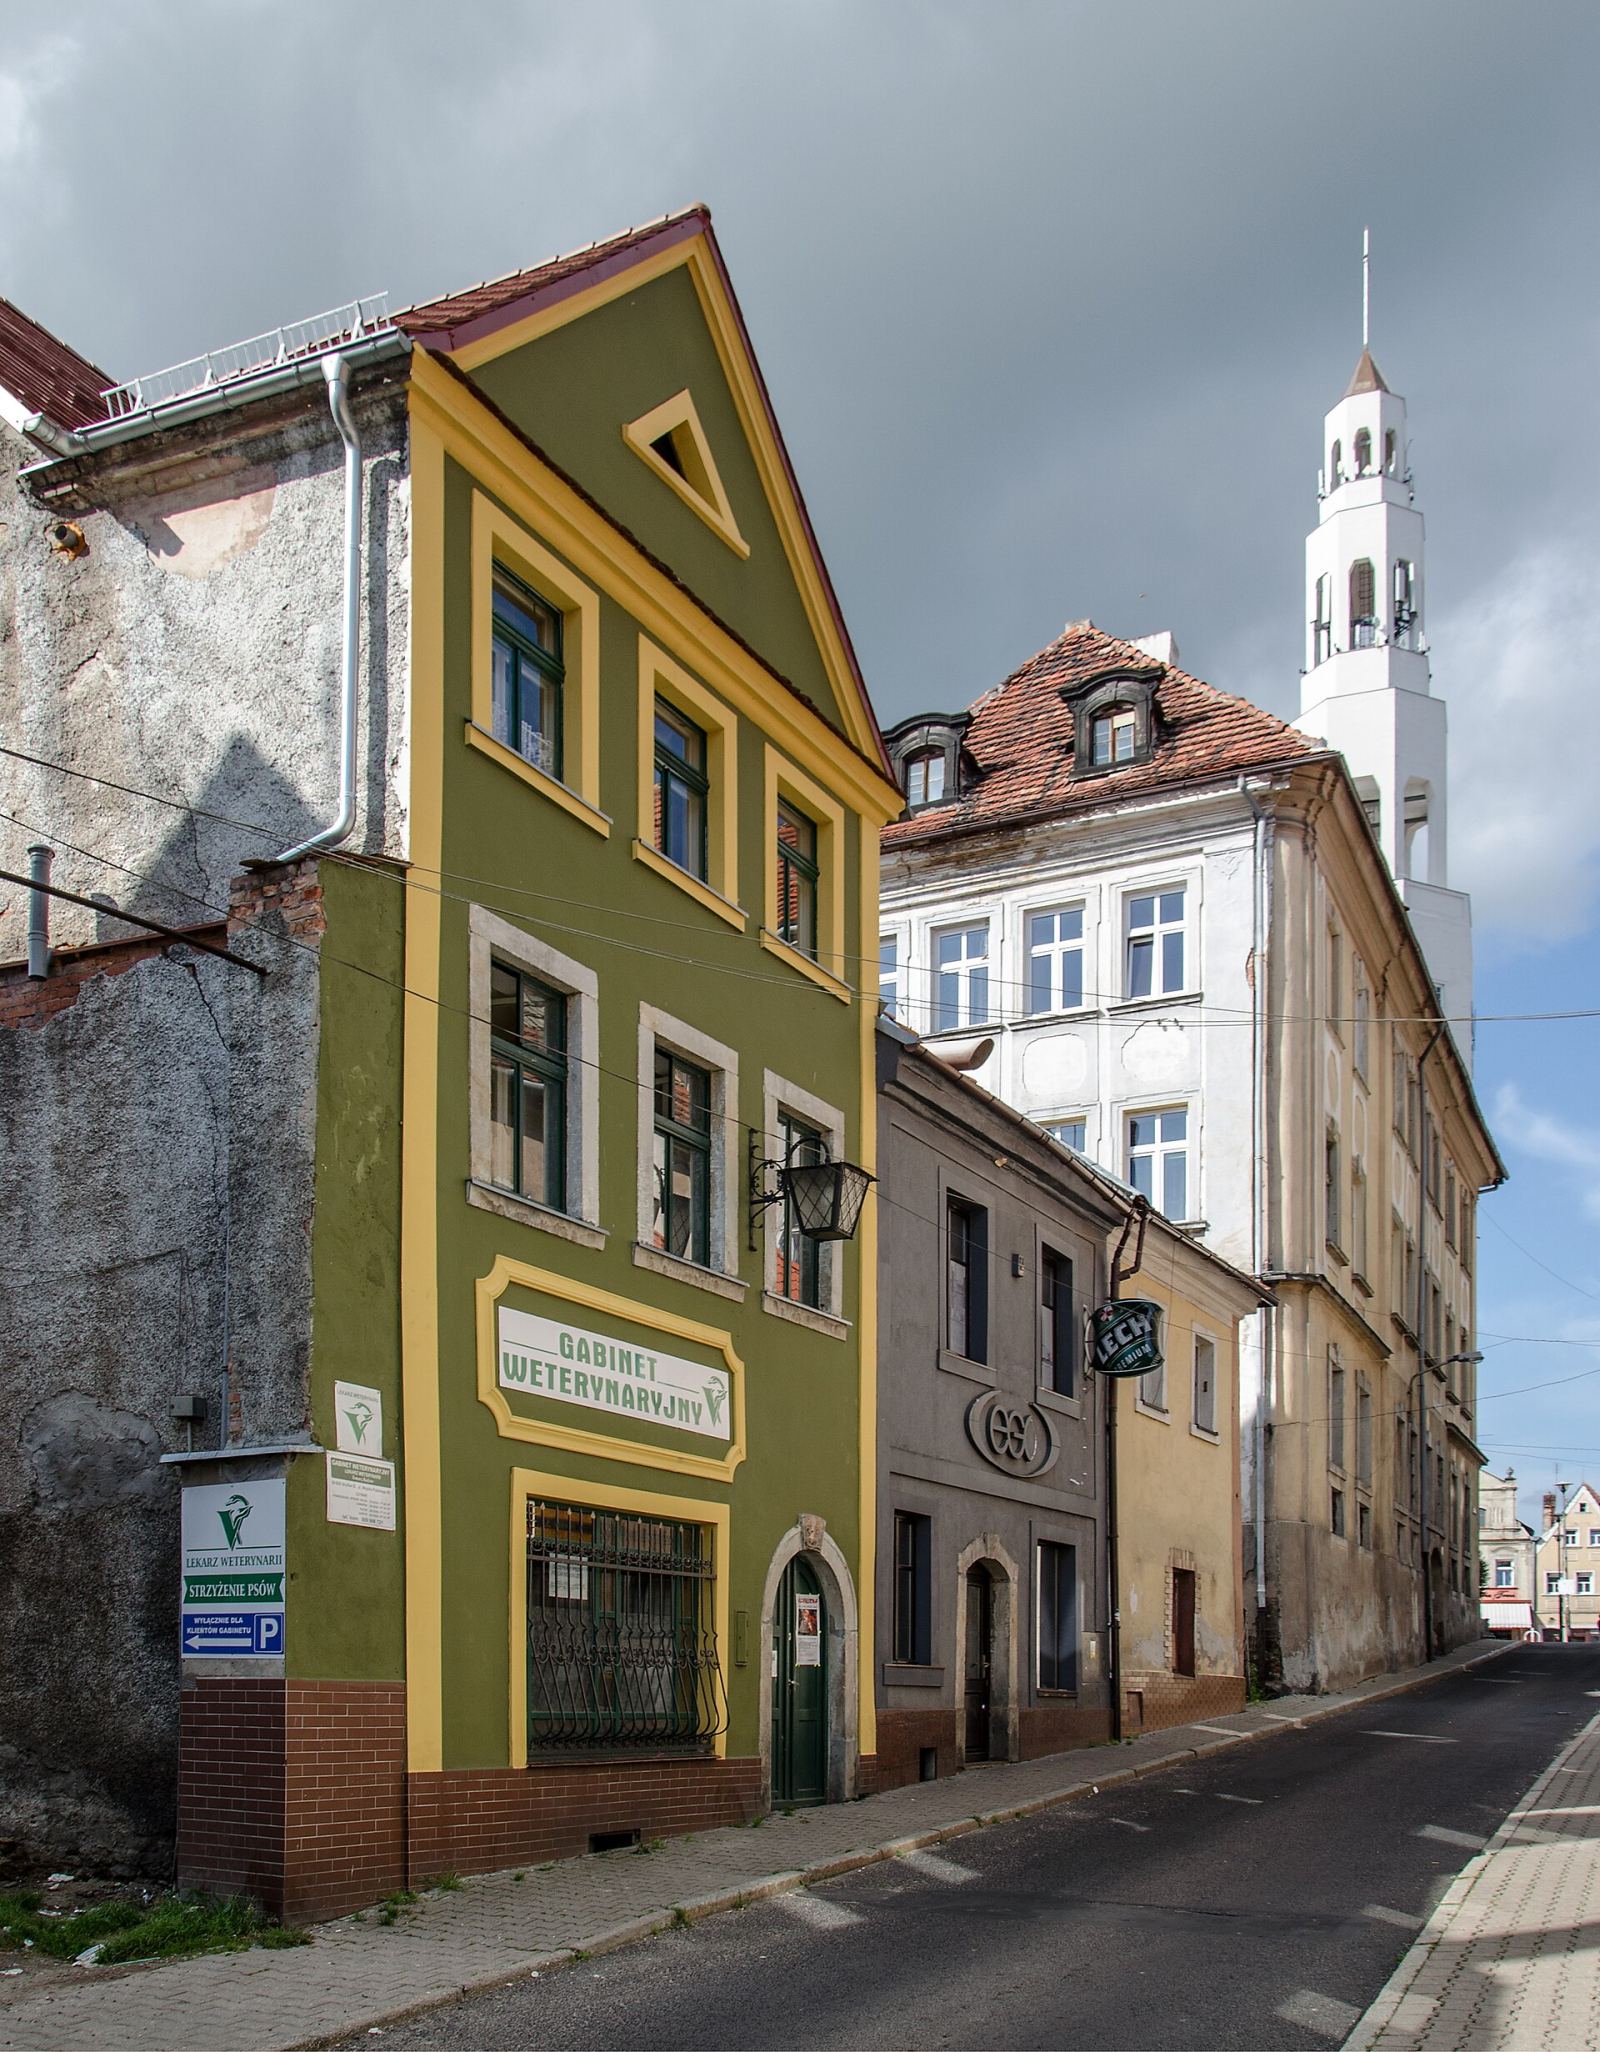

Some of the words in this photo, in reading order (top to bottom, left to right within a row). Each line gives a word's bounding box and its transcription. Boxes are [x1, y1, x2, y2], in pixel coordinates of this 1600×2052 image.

[1097, 1314, 1152, 1365] LECH
[559, 1332, 658, 1382] GABINET
[503, 1352, 703, 1426] WETERYNARYJNY
[186, 1556, 219, 1568] LEKARZ
[220, 1554, 282, 1567] WETERYNARII
[189, 1581, 246, 1598] STRZYŻENIE
[247, 1579, 277, 1597] PSÓW
[186, 1626, 218, 1634] KLIENTÓW
[218, 1626, 252, 1634] GABINETU
[230, 1616, 244, 1624] DLA
[260, 1617, 279, 1649] P
